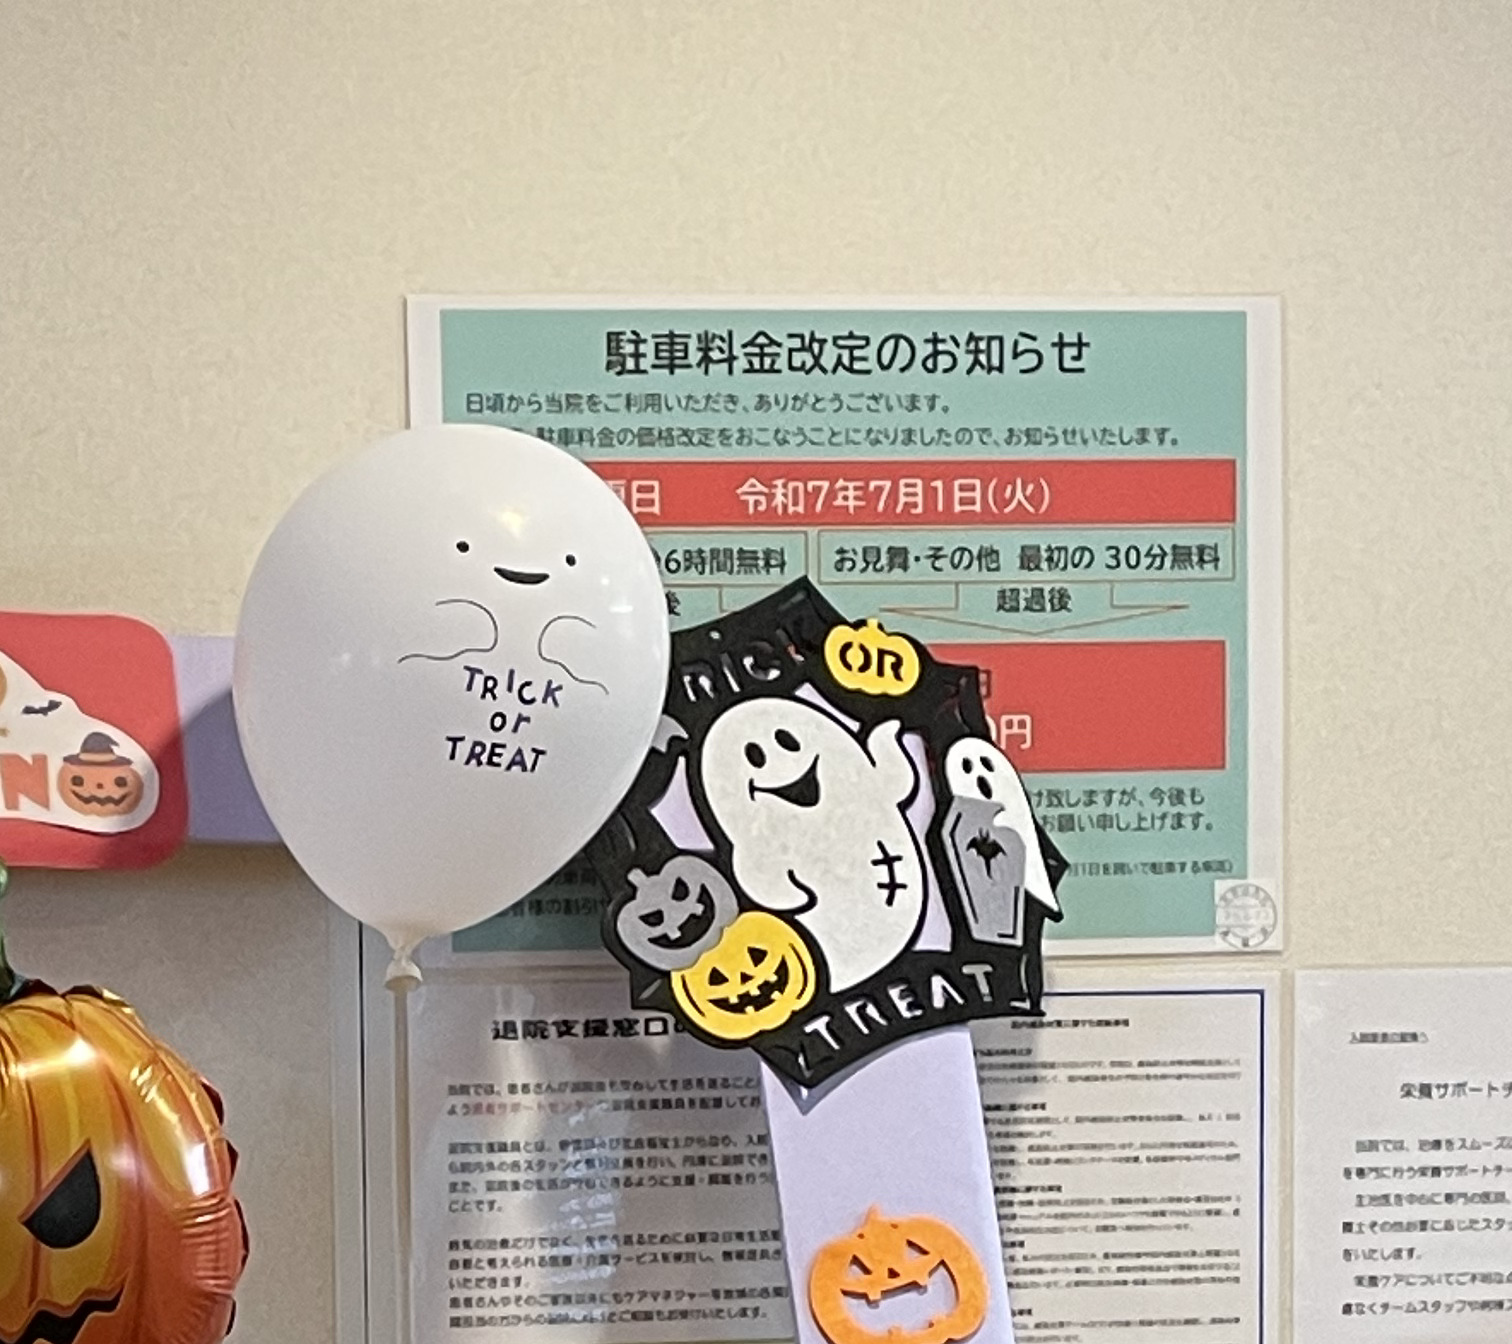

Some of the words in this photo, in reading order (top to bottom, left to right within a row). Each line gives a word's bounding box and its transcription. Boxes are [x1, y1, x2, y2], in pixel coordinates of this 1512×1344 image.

[604, 329, 1091, 376] 駐車料金改定のお知らせ
[465, 391, 951, 415] 日頃から当院をご利用いただき、ありがとうございます。
[512, 425, 1180, 449] 駐車料金の価格改定をおこなうことになりましたので、お知らせいたします。
[734, 477, 1051, 515] 令和7年7月1日(火)
[1017, 544, 1095, 572] 最初の
[1104, 542, 1220, 571] 30分無料
[996, 587, 1073, 613] 超過後
[839, 640, 905, 682] OR
[463, 665, 564, 708] TRICK
[489, 711, 531, 734] or
[445, 735, 547, 774] TREAT
[803, 963, 993, 1050] TREAT
